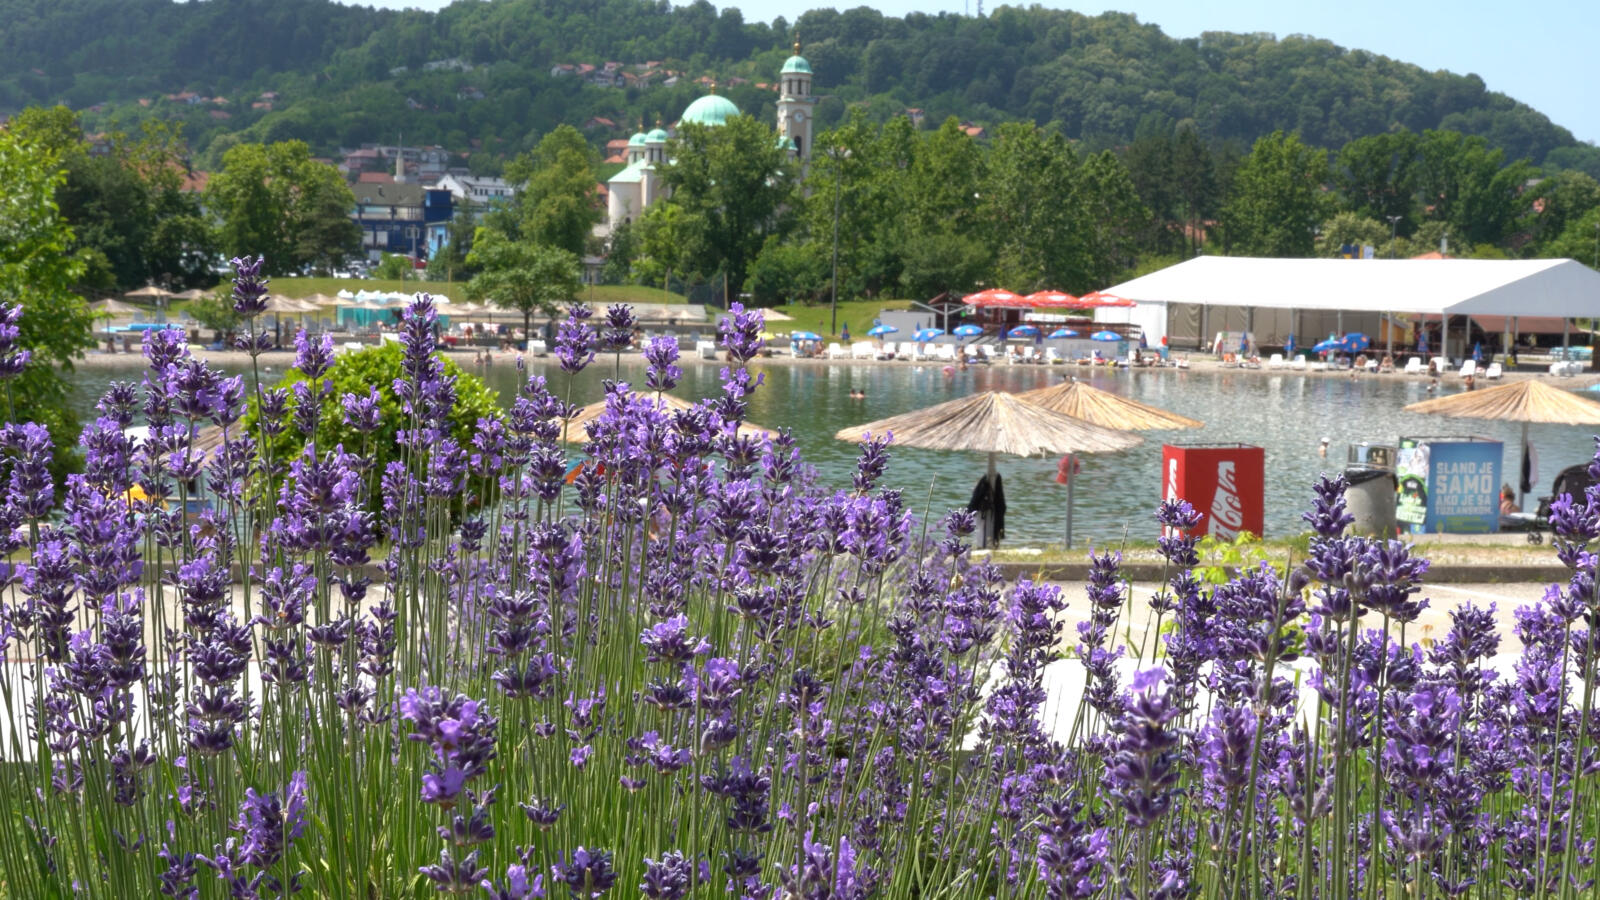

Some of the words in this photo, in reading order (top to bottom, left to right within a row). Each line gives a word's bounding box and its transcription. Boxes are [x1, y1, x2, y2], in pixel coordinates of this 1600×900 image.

[1436, 462, 1476, 474] SLANO
[1479, 462, 1493, 474] JE
[1436, 475, 1492, 494] SAMO
[1435, 495, 1458, 506] AKO
[1461, 495, 1475, 506] JE
[1477, 495, 1491, 506] SA
